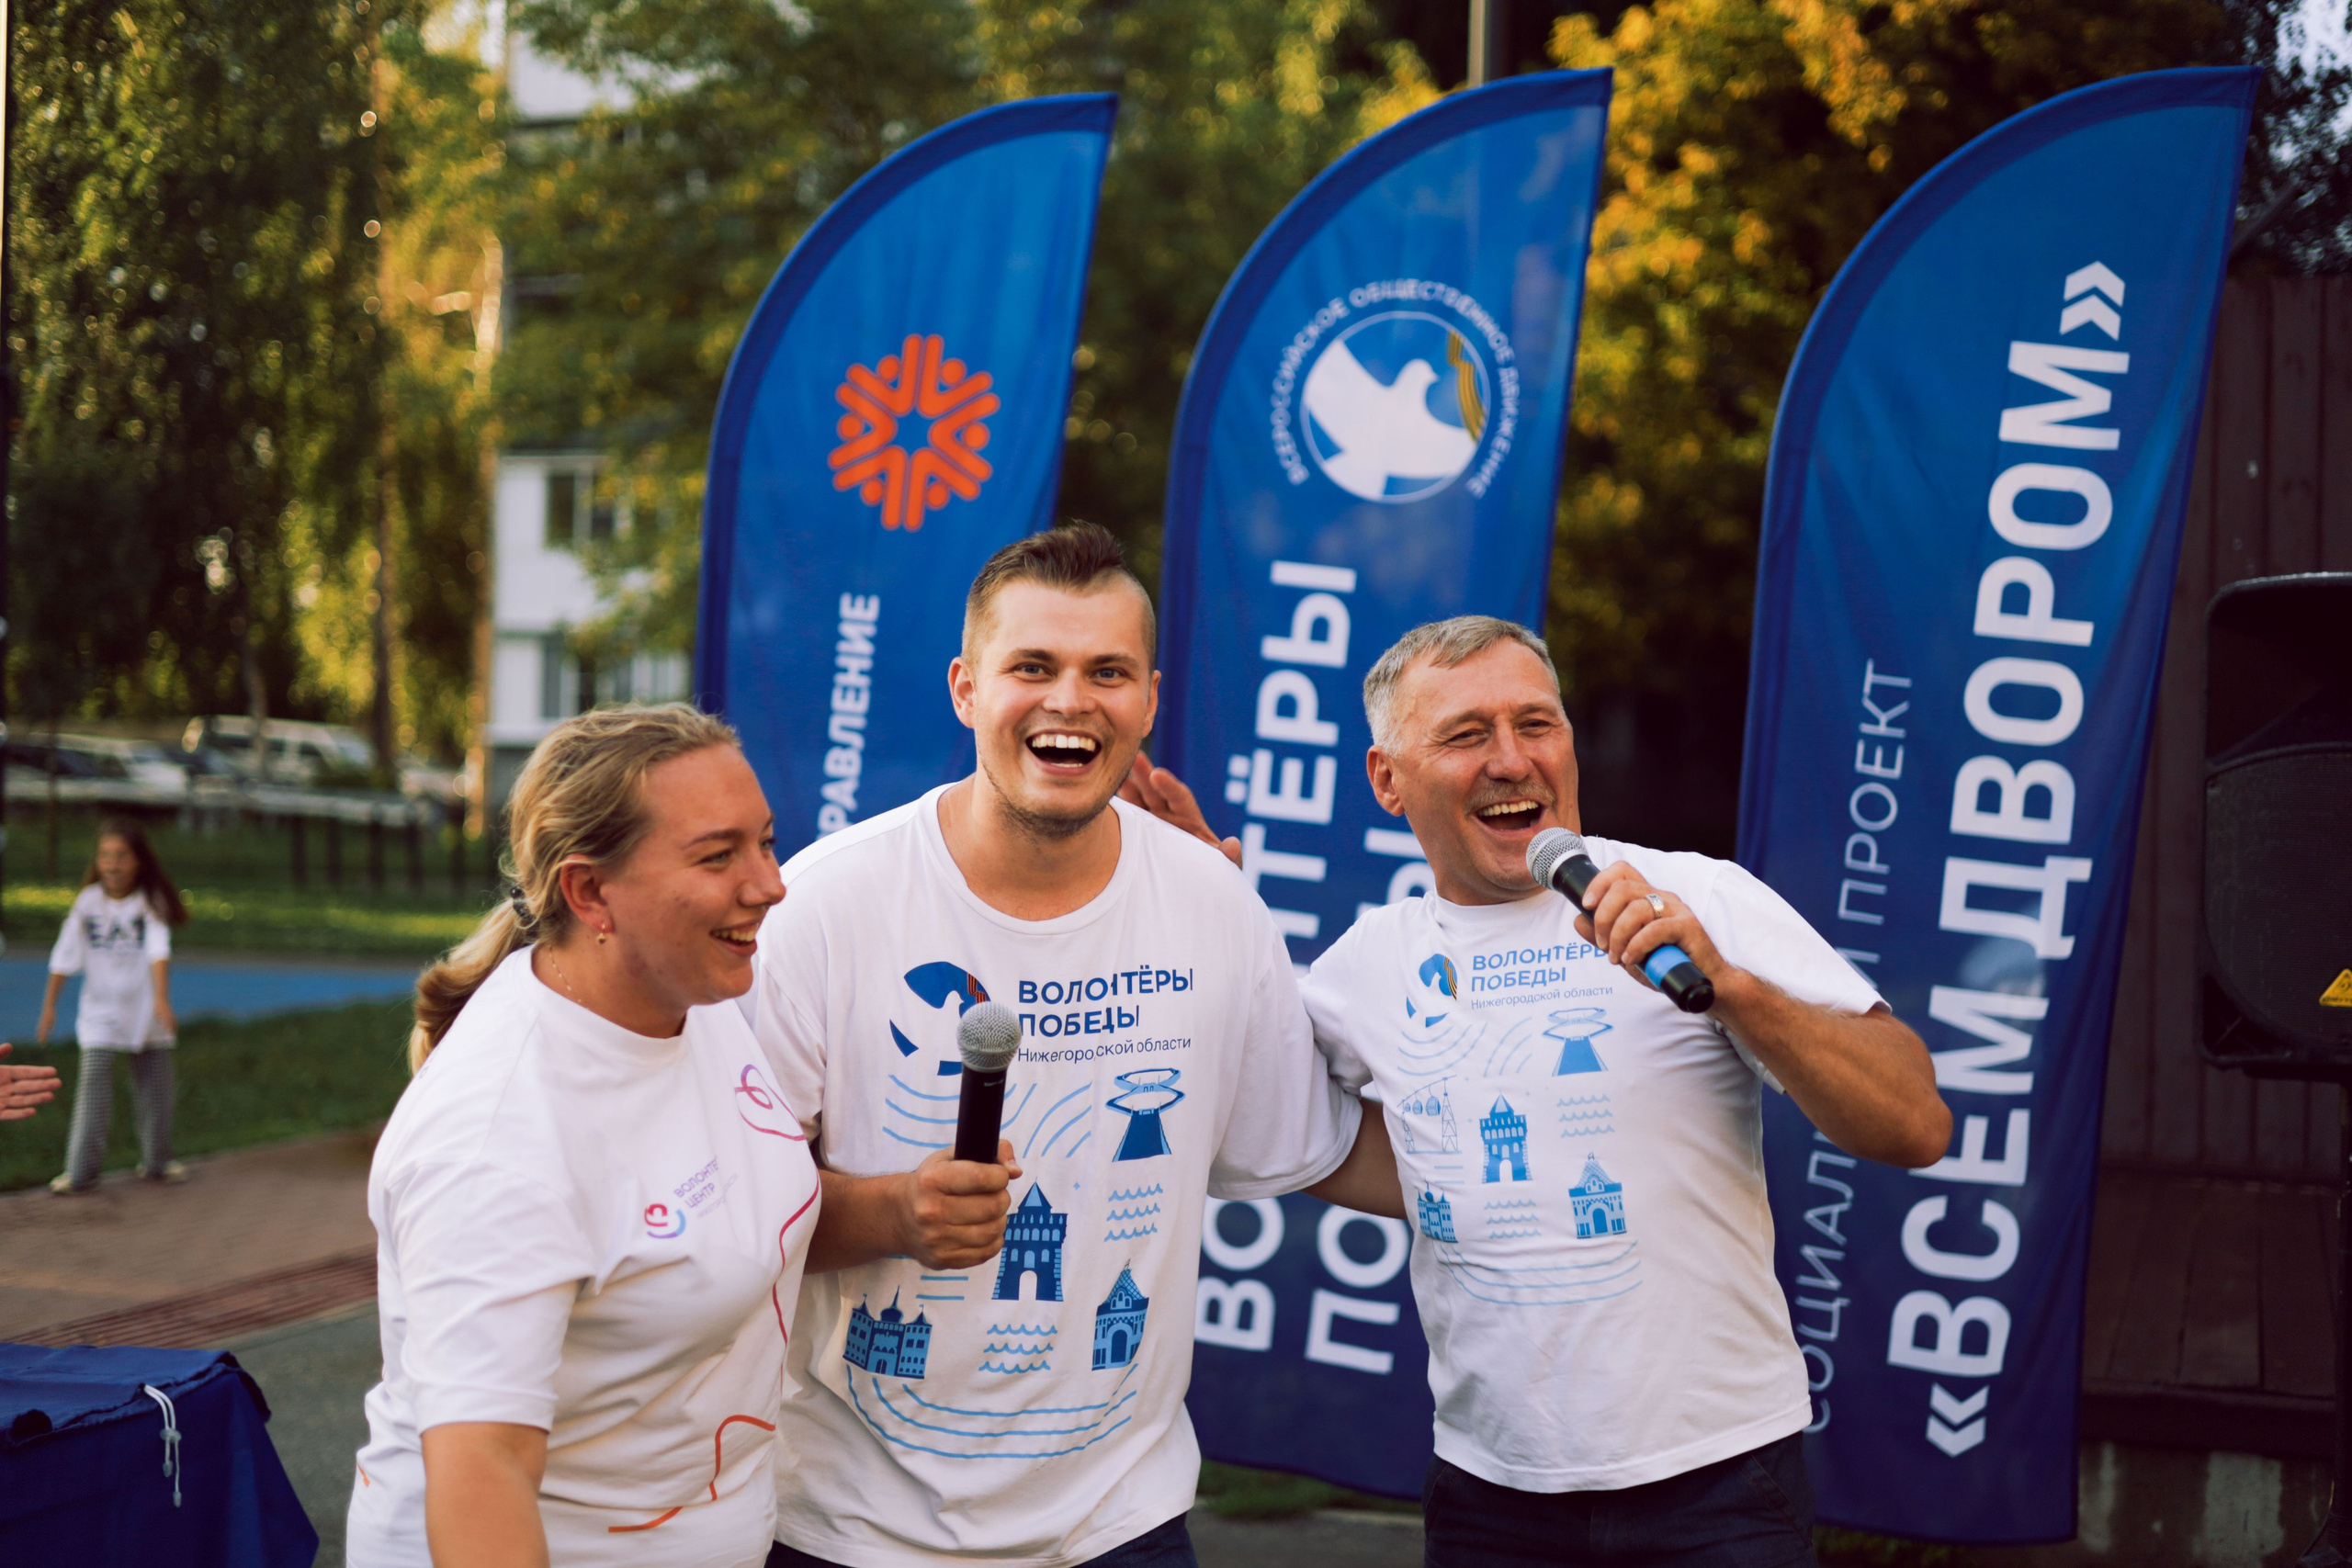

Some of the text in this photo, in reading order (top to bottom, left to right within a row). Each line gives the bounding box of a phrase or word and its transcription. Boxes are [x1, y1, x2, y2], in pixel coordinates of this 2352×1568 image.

[1939, 260, 2131, 960] ДВОРОМ»
[1838, 658, 1912, 925] ПРОЕКТ
[1471, 966, 1566, 992] ПОБЕДЫ
[1471, 986, 1613, 1010] Нижегородской области
[1017, 1038, 1192, 1065] Нижегороской области
[684, 1182, 715, 1209] ЦЕНТР
